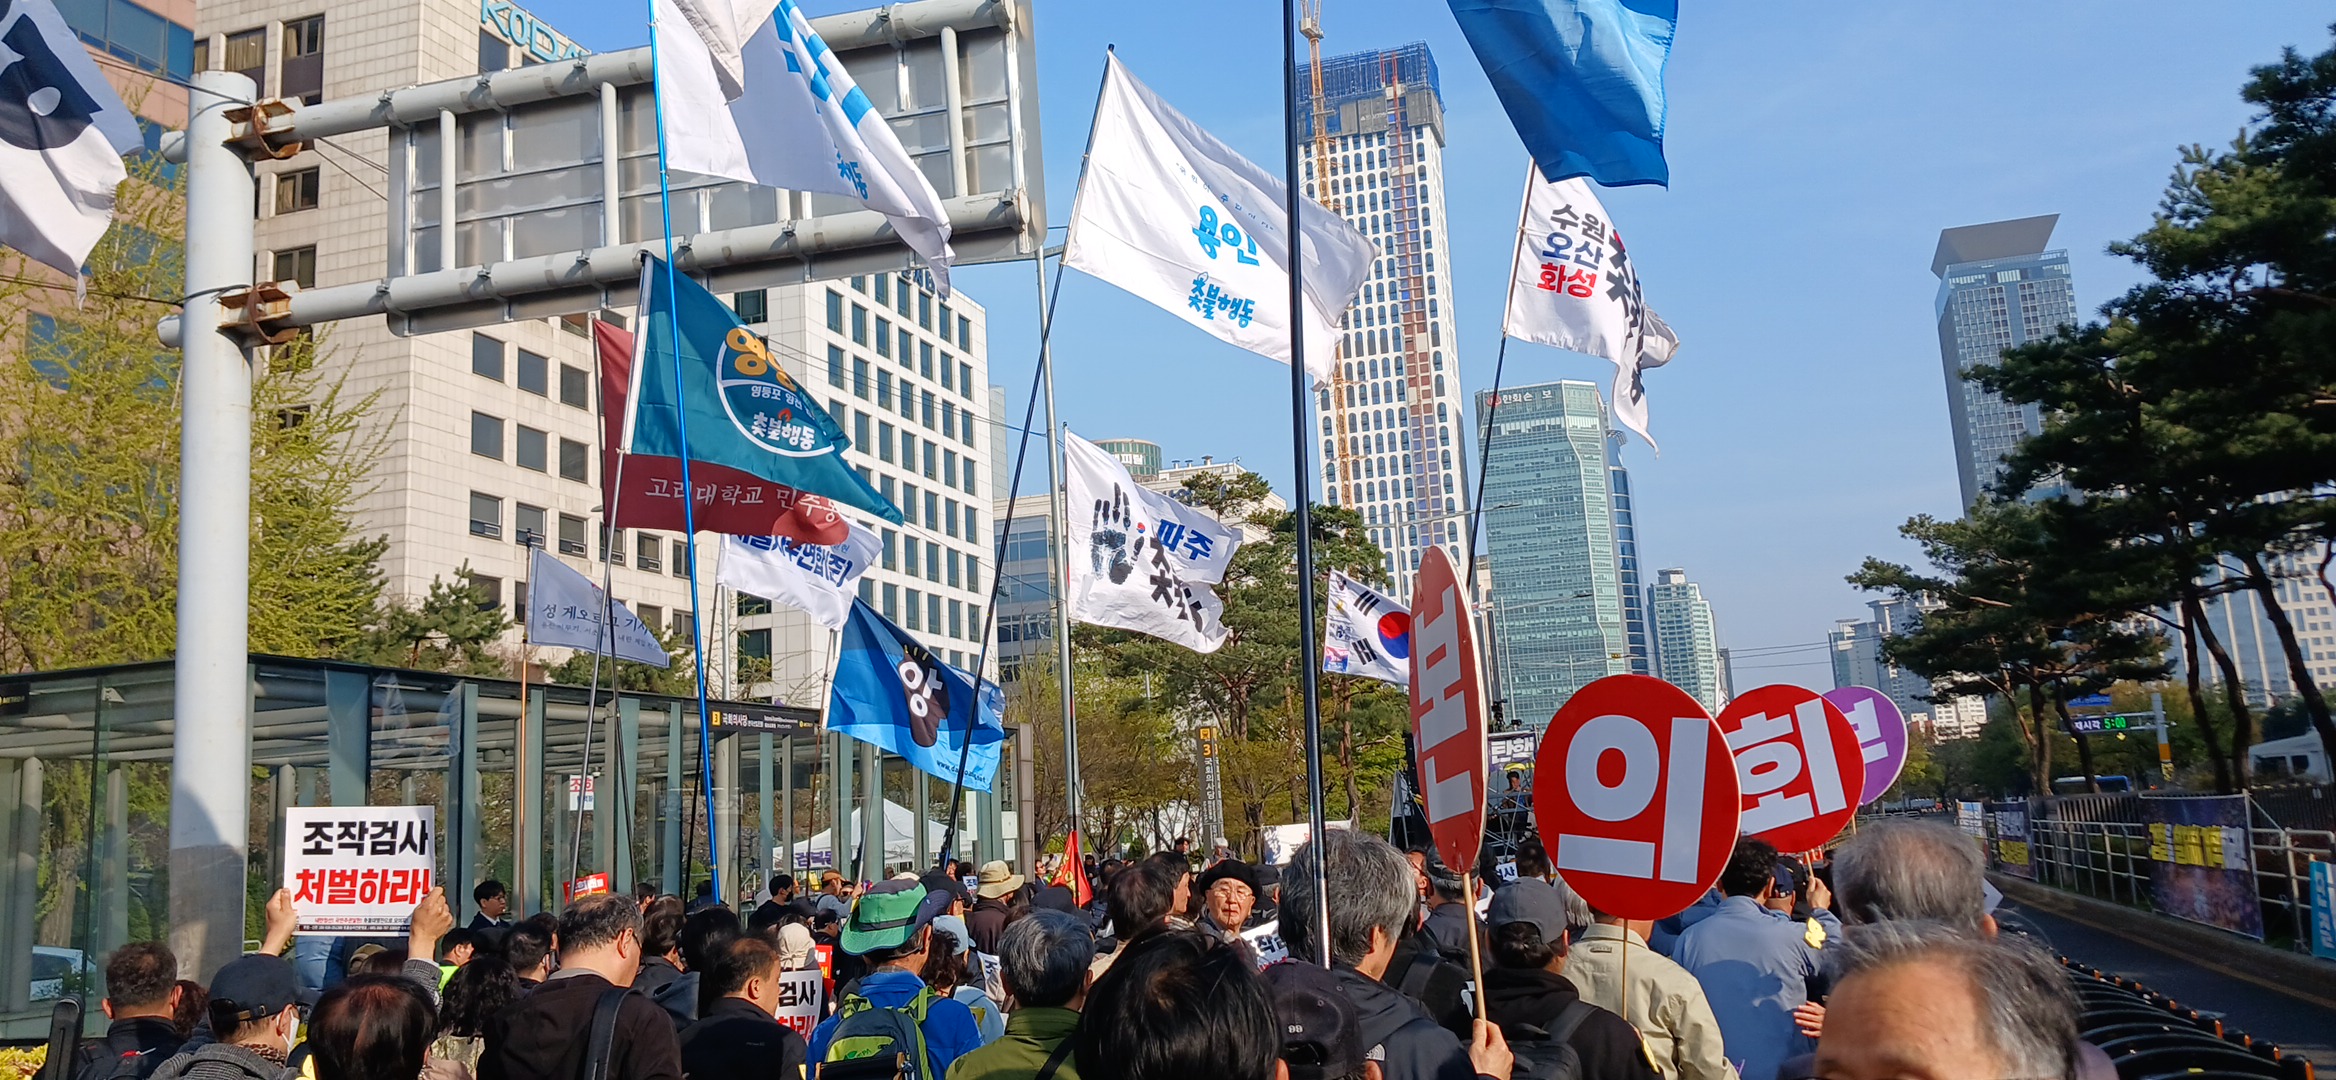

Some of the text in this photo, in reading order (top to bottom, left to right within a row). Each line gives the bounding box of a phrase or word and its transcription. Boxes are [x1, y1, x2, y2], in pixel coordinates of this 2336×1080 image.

[1192, 205, 1260, 267] 용인
[1550, 203, 1606, 245] 수원
[1542, 231, 1603, 270] 오산
[1537, 262, 1597, 299] 화성
[1188, 277, 1255, 328] 촛불행동
[1503, 389, 1553, 404] 한화손 보
[751, 411, 816, 451] 촛불행동
[1157, 518, 1214, 561] 파주
[542, 604, 557, 619] 성
[899, 661, 943, 717] 앙
[1413, 584, 1475, 825] 본
[722, 713, 748, 727] 국회의사당
[2104, 717, 2127, 729] 5:00
[1203, 744, 1212, 756] 3
[1491, 737, 1535, 765] 탄핵
[1727, 697, 1847, 834] 회
[936, 760, 986, 783] www.daoang.net
[1204, 757, 1216, 800] 국회의사당
[1557, 714, 1709, 884] 의
[302, 820, 429, 856] 조작검사
[294, 869, 430, 904] 처벌하라!
